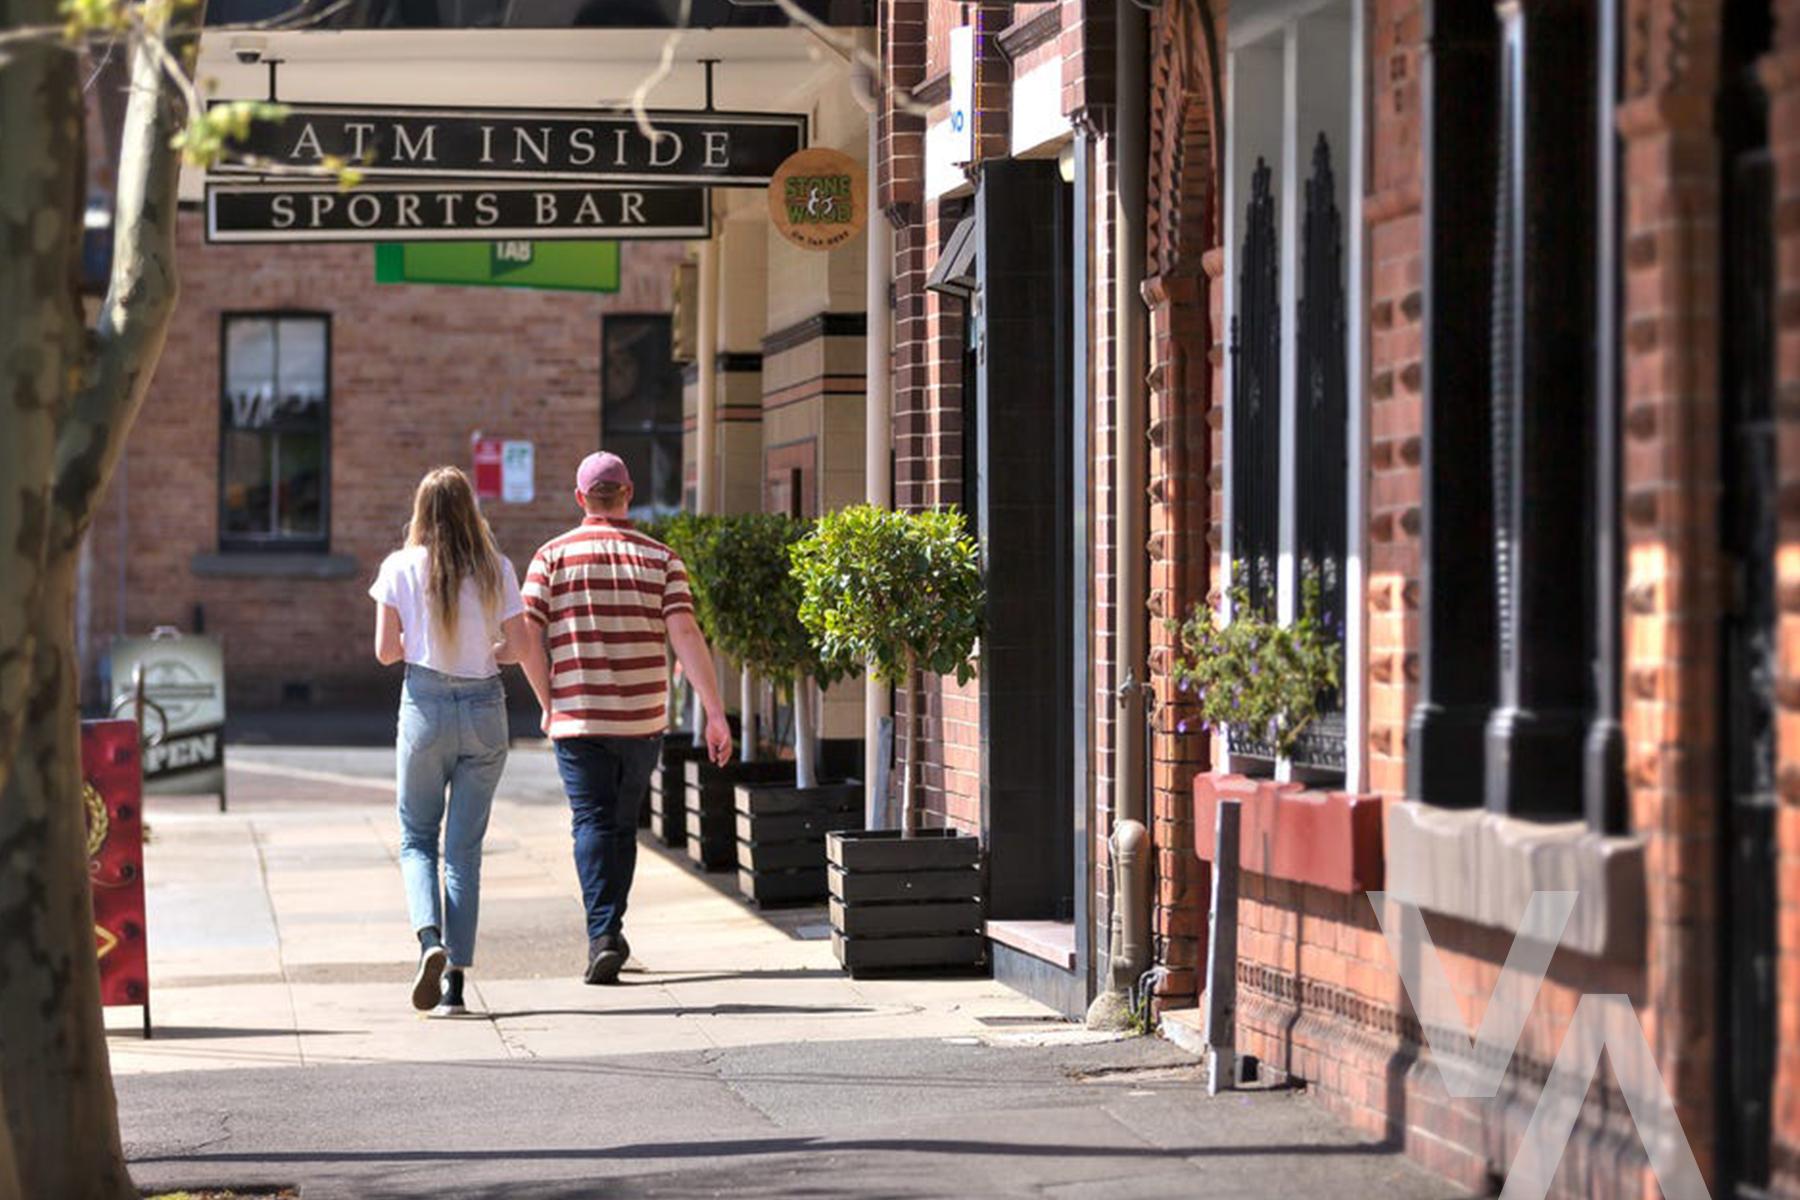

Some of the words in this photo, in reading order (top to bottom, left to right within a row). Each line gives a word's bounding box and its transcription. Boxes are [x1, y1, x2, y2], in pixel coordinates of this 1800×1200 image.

[289, 121, 438, 161] ATM
[479, 125, 730, 168] INSIDE
[269, 191, 500, 229] SPORTS
[533, 191, 647, 225] BAR
[143, 733, 217, 773] PEN
